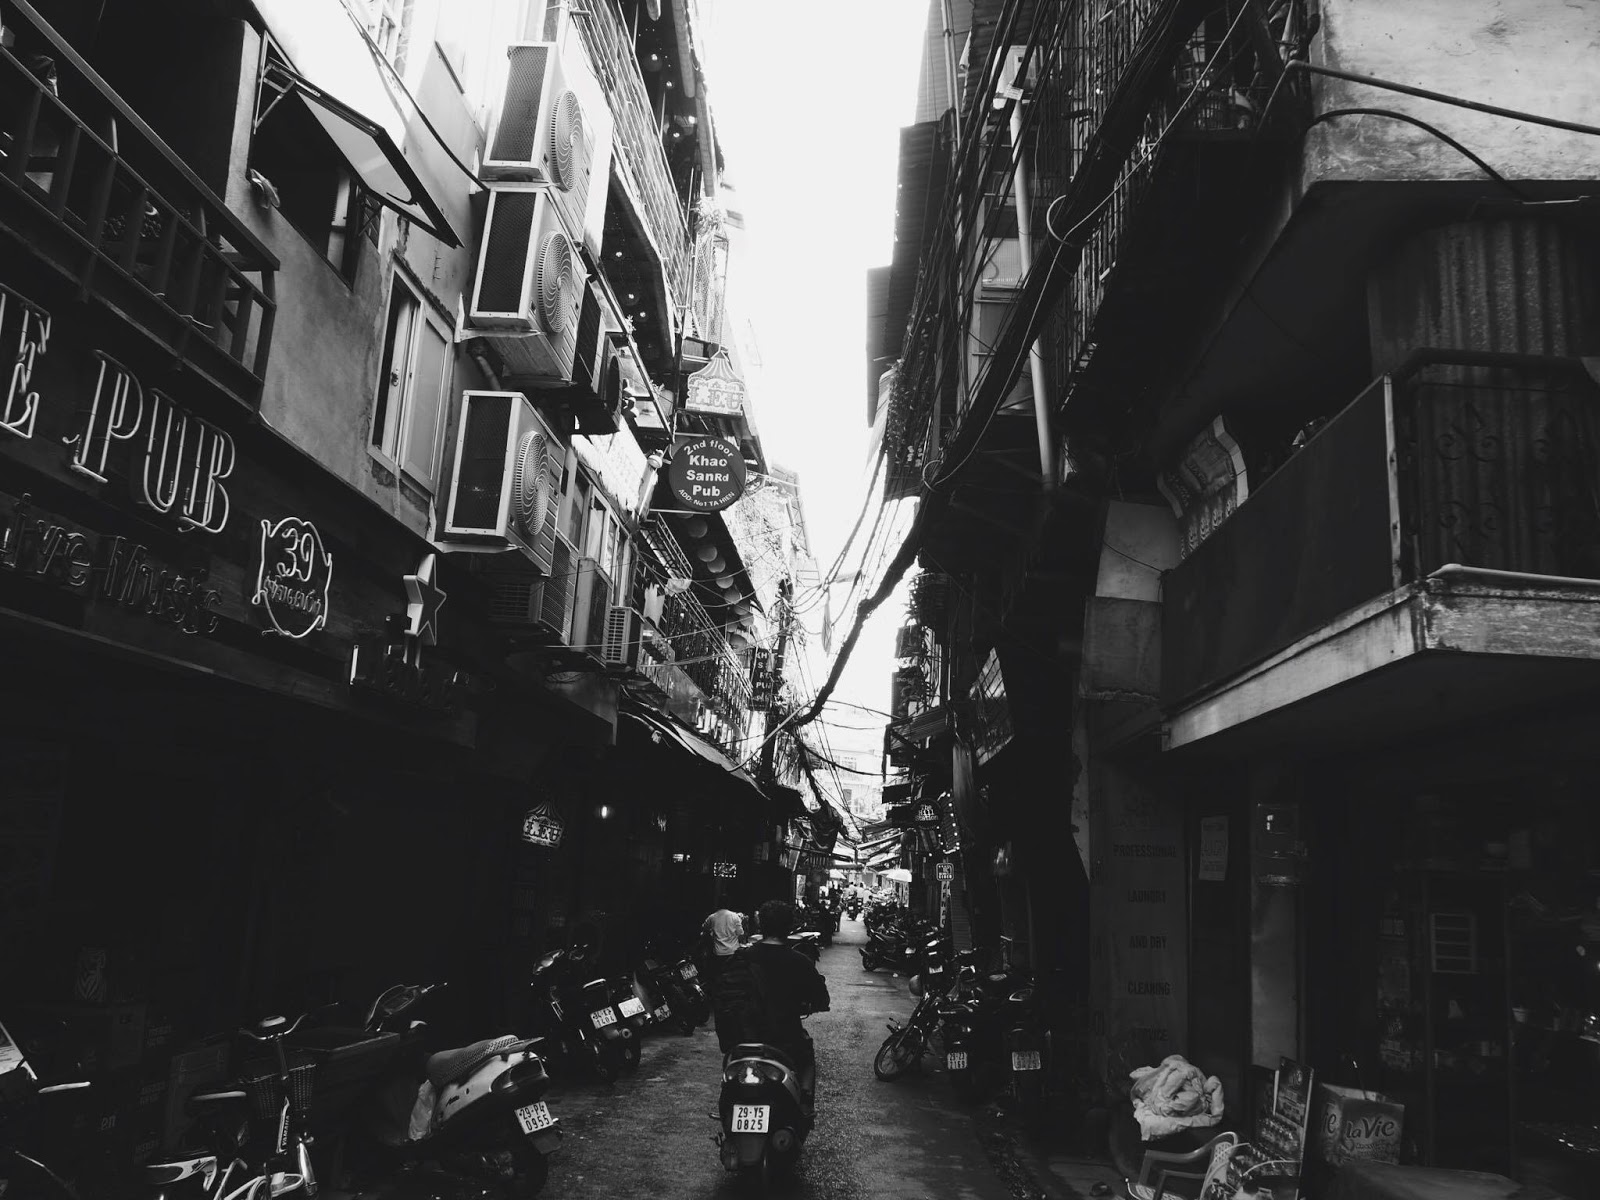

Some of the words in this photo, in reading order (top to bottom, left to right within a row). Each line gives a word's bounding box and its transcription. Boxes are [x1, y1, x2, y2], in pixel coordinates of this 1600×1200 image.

[62, 349, 236, 536] PUB
[683, 440, 706, 456] 2nd
[709, 440, 734, 458] floor
[689, 455, 728, 467] Khao
[692, 484, 721, 497] Pub
[276, 527, 315, 583] 39
[1113, 844, 1177, 857] PROFESSIONAL
[1127, 890, 1167, 903] LAUNDRY
[1129, 935, 1147, 949] AND
[1149, 935, 1167, 949] DRY
[1127, 981, 1171, 995] CLEANING
[520, 1103, 545, 1120] 29-P4
[738, 1107, 764, 1118] 29-Y5
[525, 1114, 550, 1131] 0955
[737, 1119, 763, 1130] 0825
